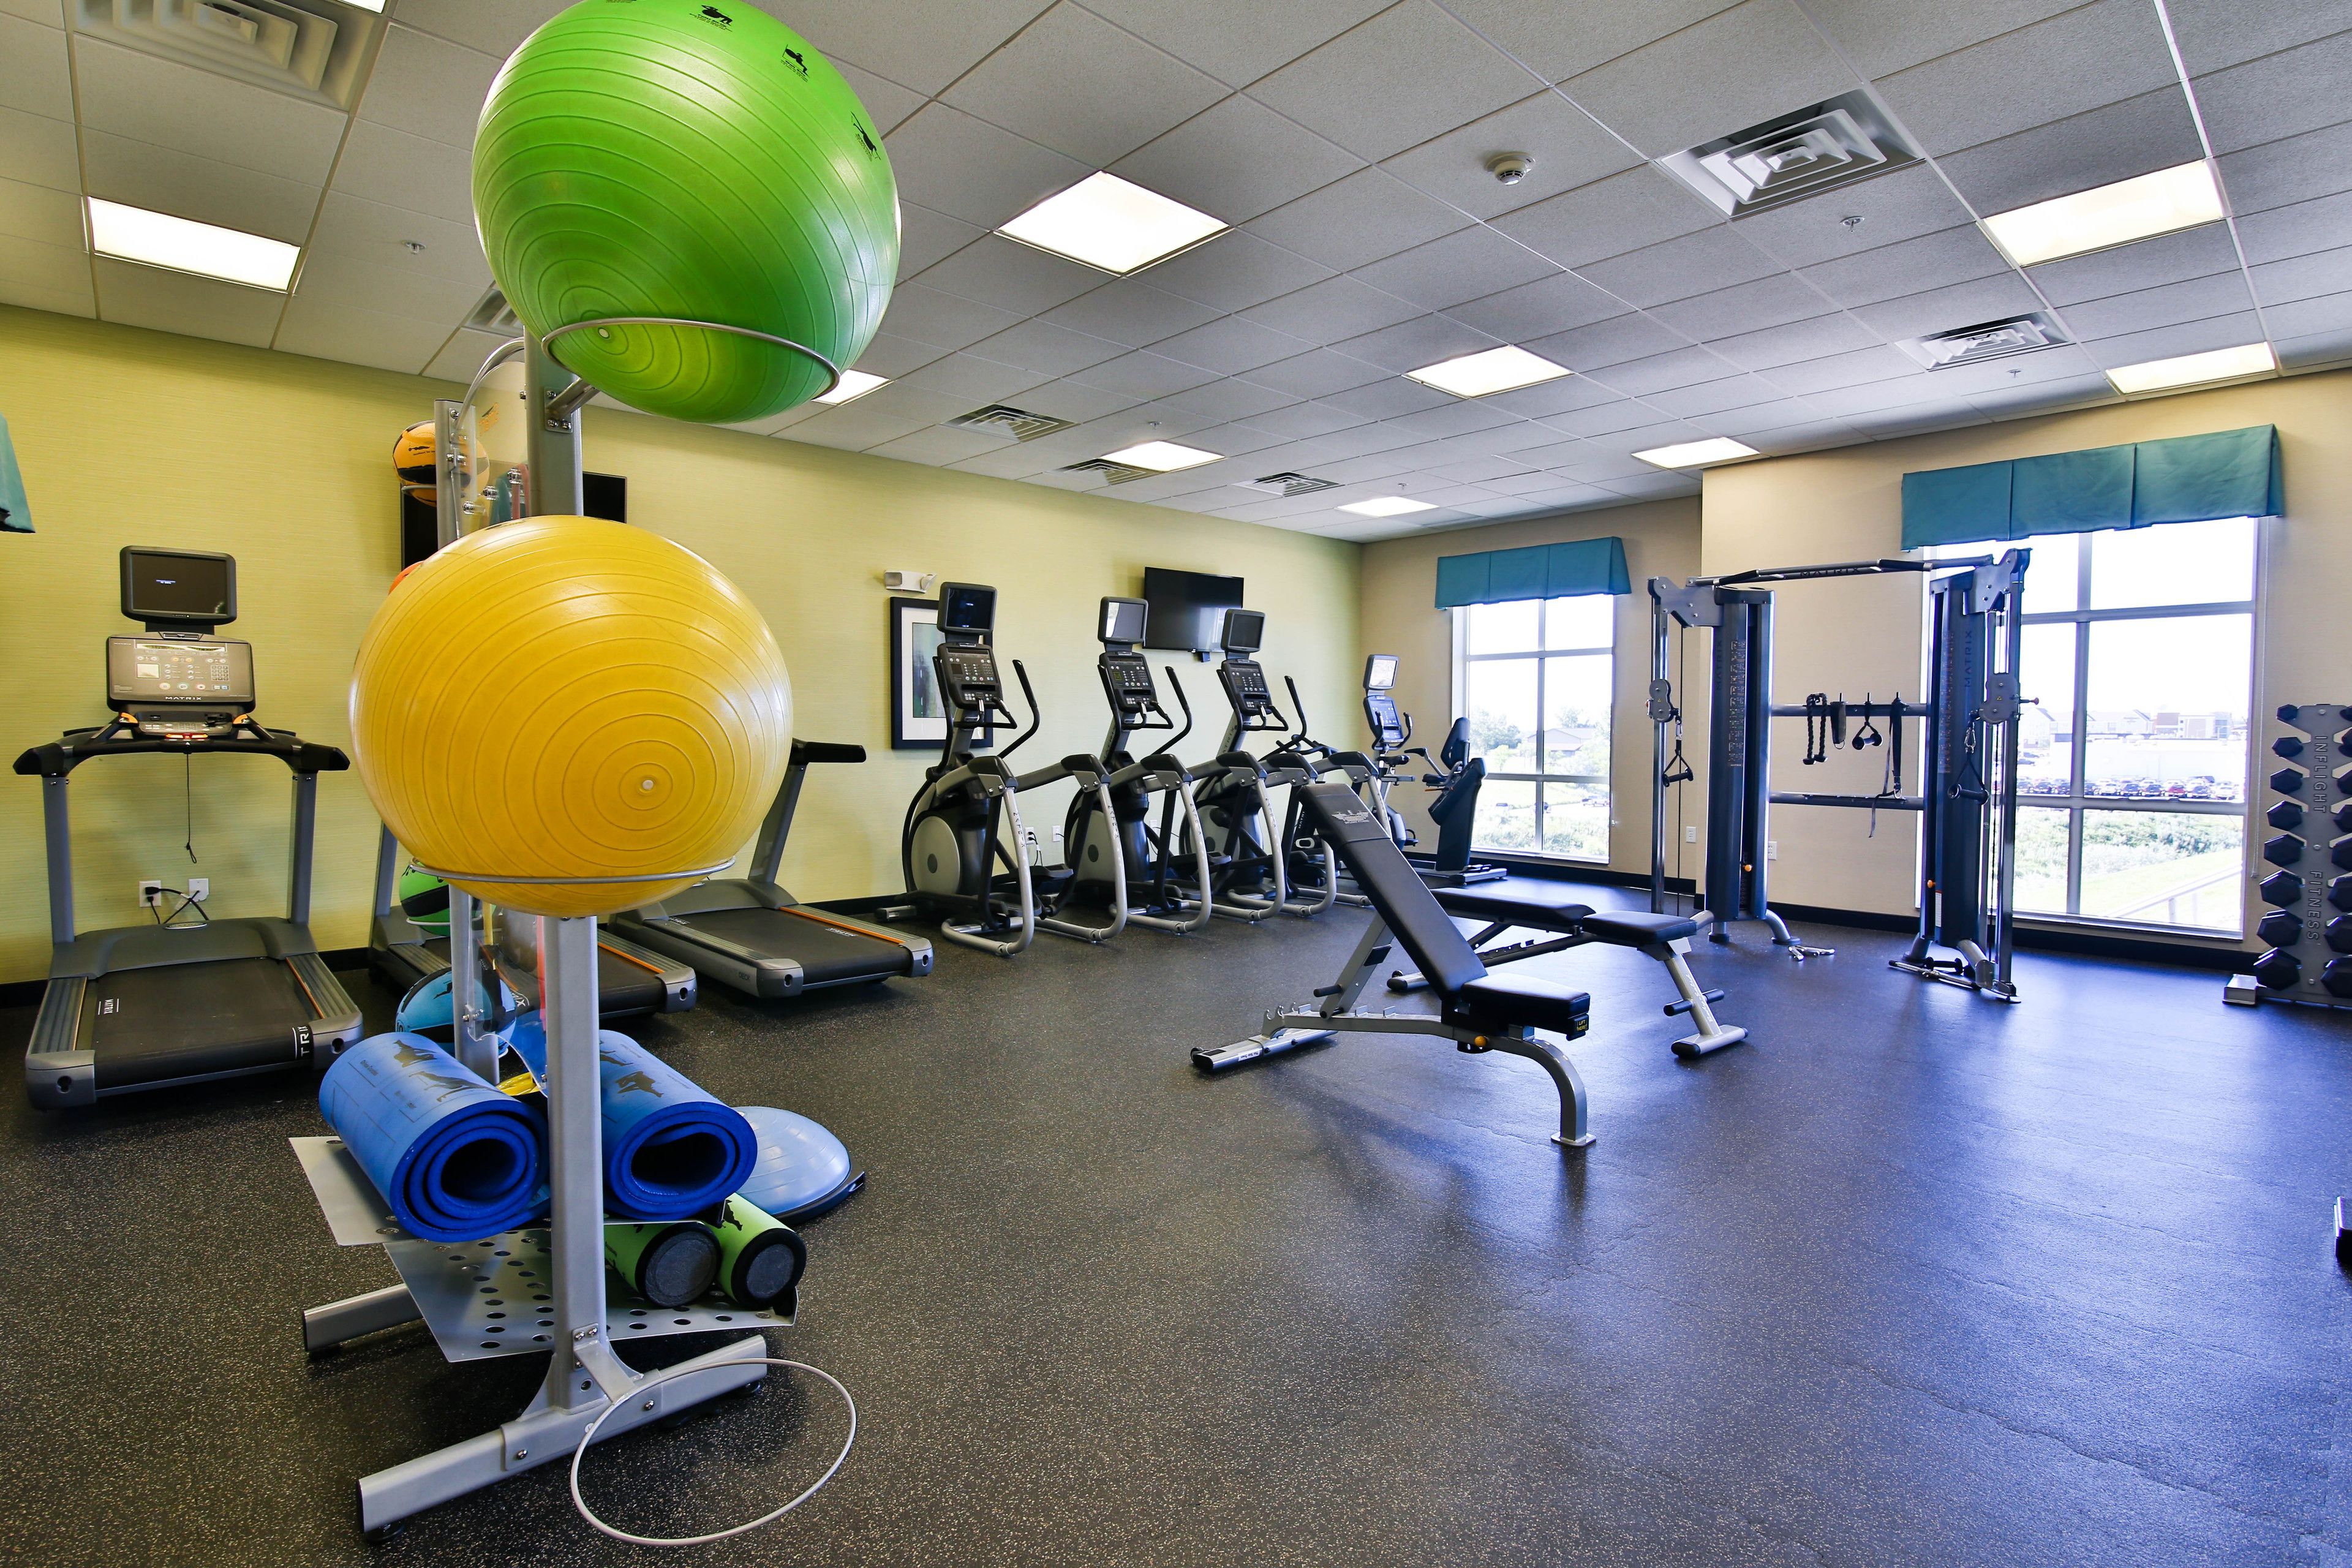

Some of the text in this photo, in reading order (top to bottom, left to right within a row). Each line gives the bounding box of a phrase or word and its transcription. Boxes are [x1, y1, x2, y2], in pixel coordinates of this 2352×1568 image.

[1800, 567, 1860, 576] MATRIX
[2307, 736, 2328, 940] INFLIGHT FITNESS
[104, 999, 113, 1014] MATRIX
